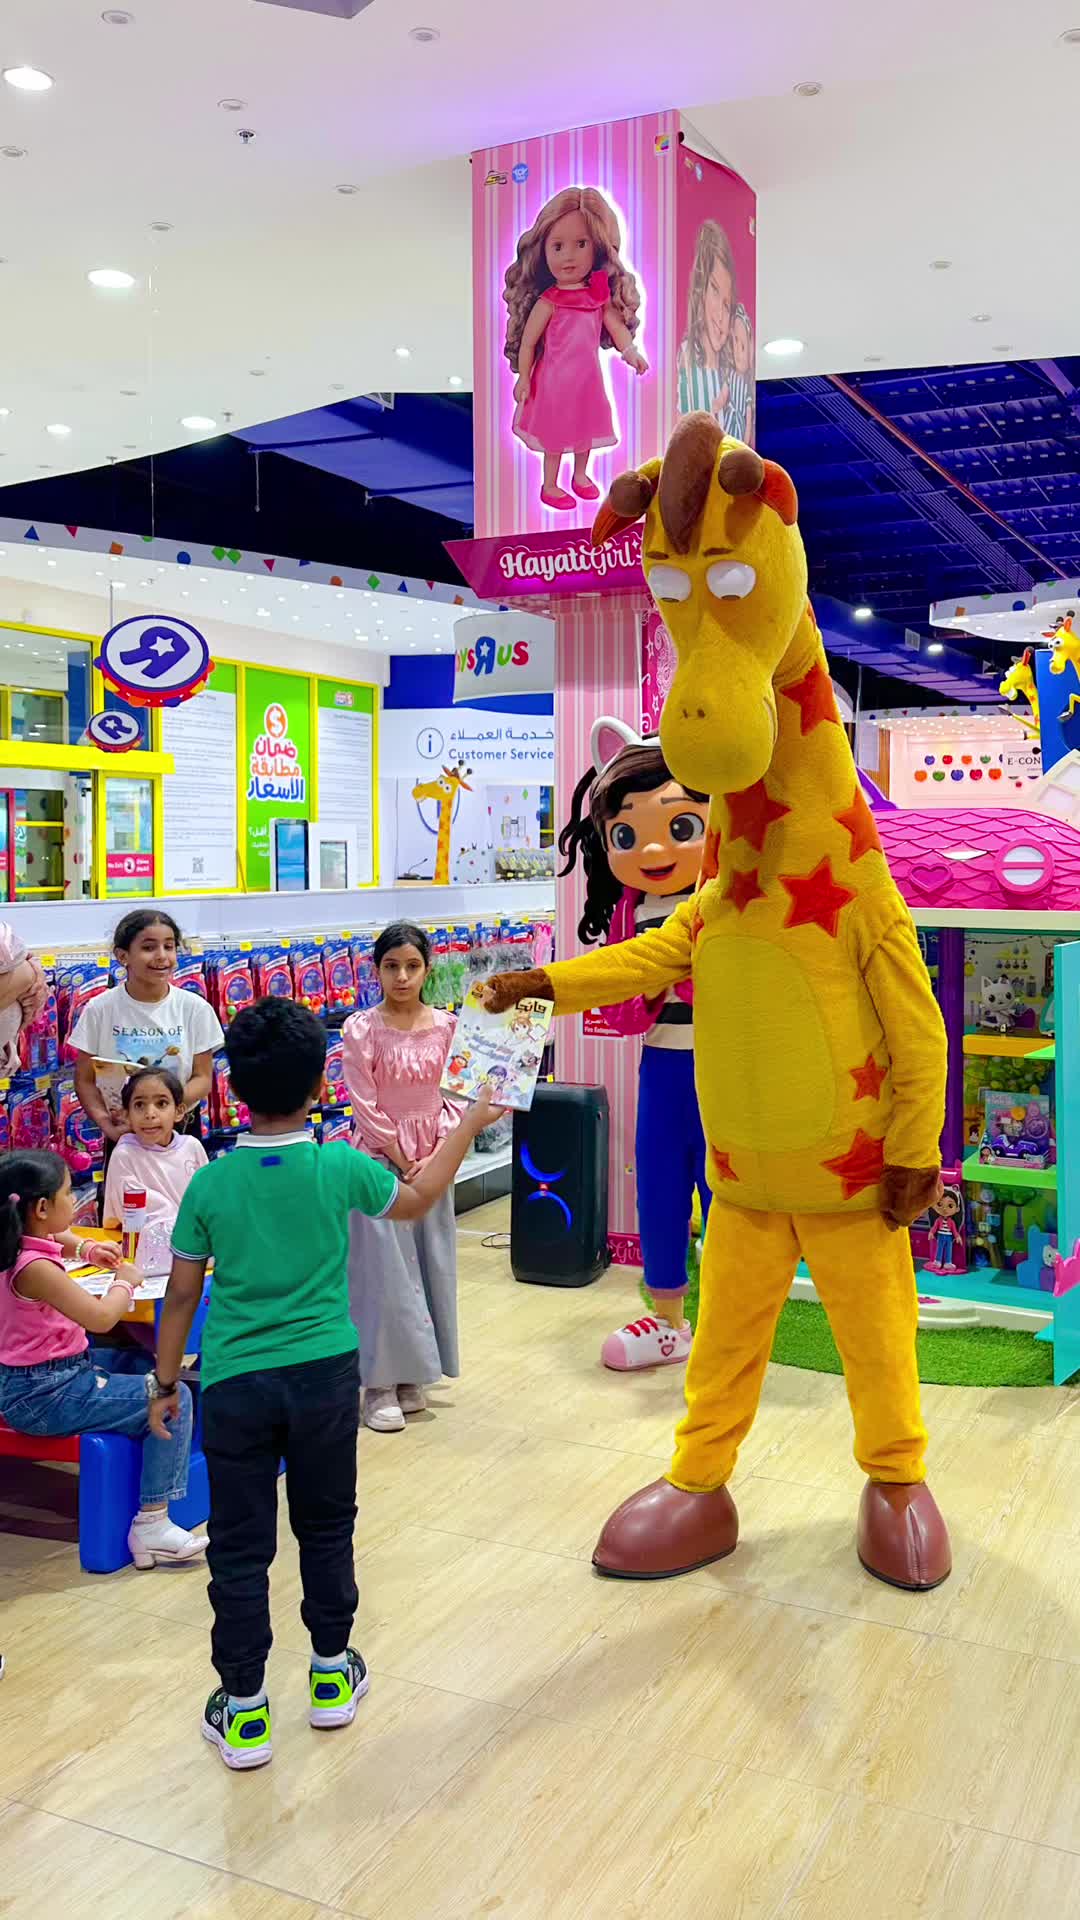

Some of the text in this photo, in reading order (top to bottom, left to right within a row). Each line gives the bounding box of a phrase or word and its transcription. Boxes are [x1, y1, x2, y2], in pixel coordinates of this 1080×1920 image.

[498, 641, 529, 666] US
[449, 727, 554, 741] خدمة العملاء
[255, 736, 296, 758] ضمان
[448, 747, 554, 760] Customer Service
[251, 756, 301, 780] مطابقة
[112, 1025, 164, 1037] SEASON
